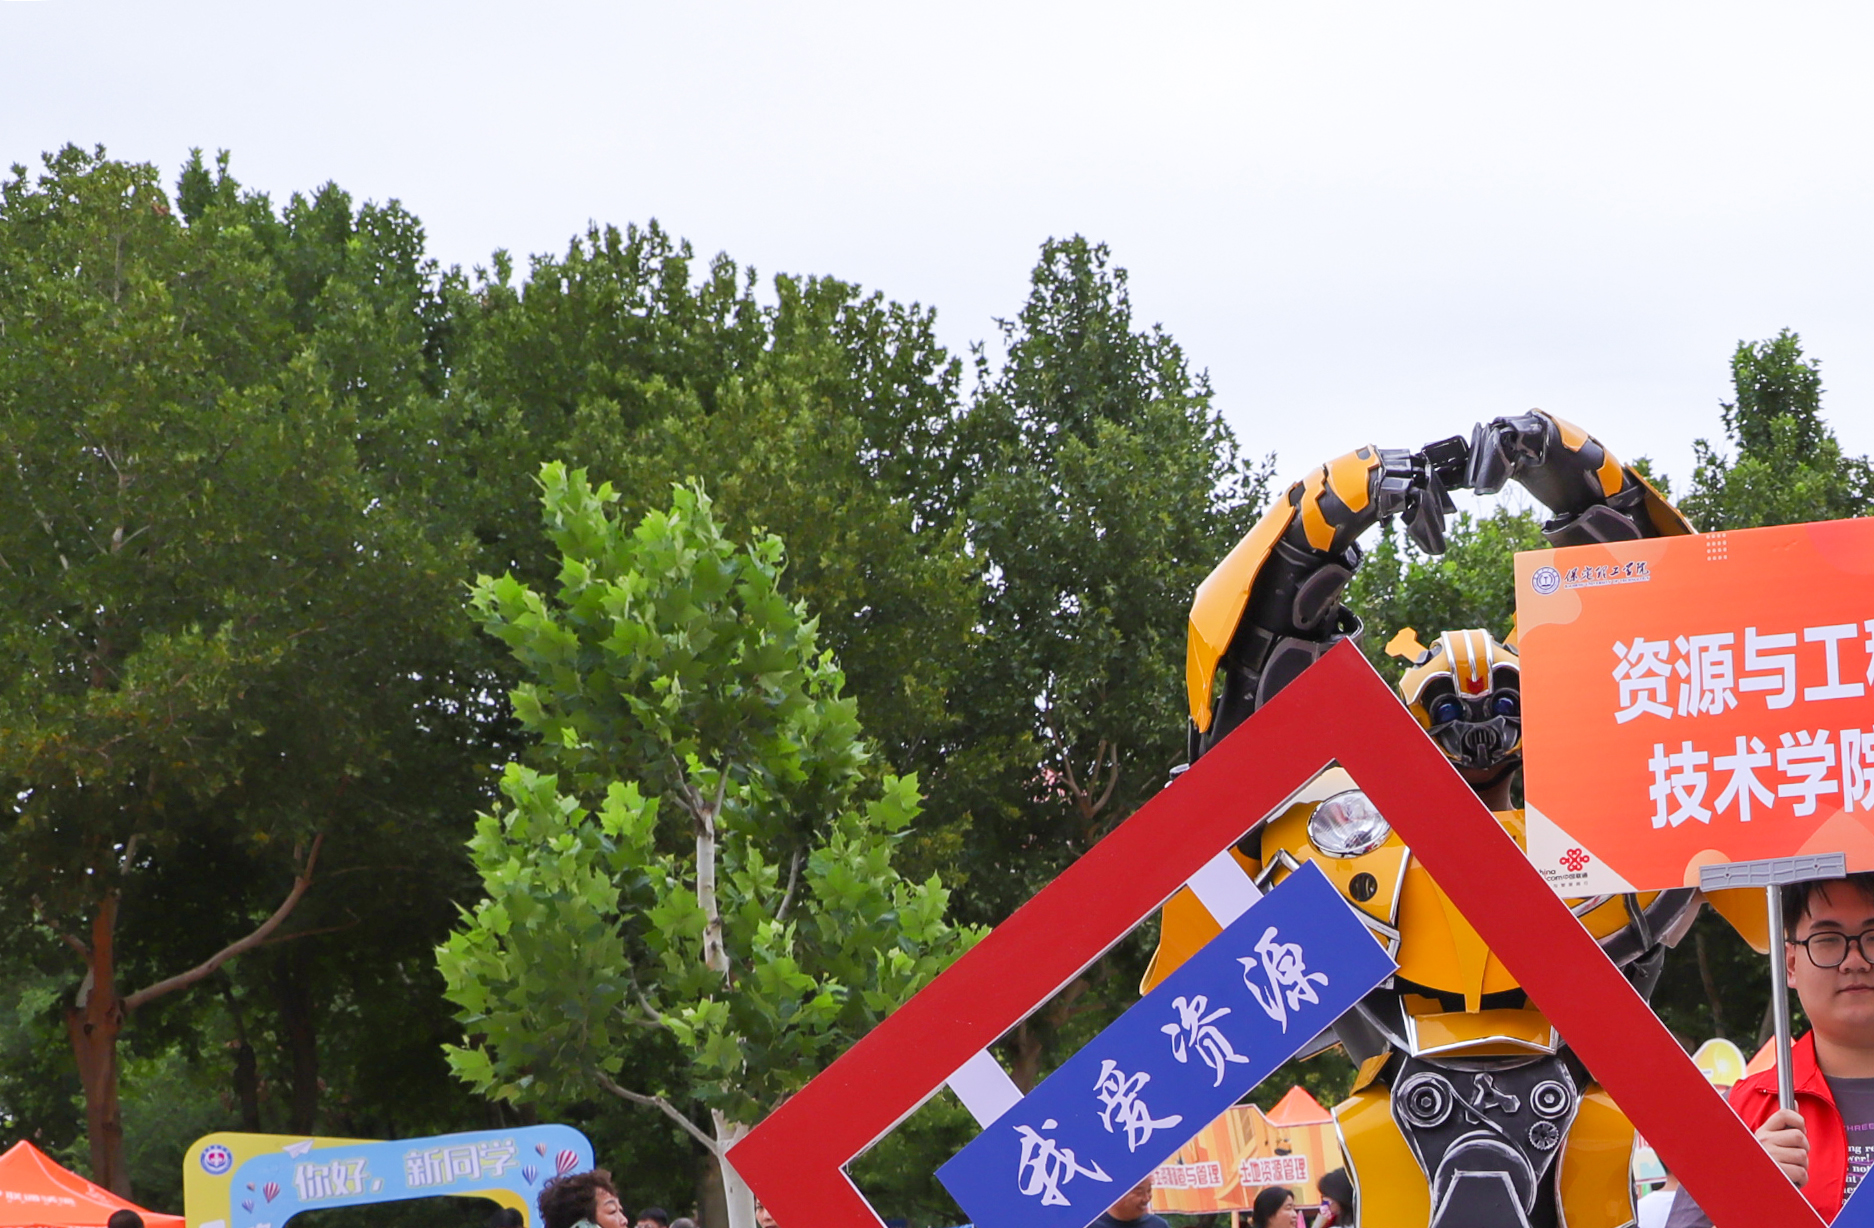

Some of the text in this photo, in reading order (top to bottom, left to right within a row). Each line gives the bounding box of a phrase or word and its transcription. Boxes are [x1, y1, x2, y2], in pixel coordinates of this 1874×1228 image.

[1017, 926, 1329, 1206] 我爱资源
[406, 1139, 518, 1187] 新同学
[1241, 1158, 1307, 1183] 土地资源管理
